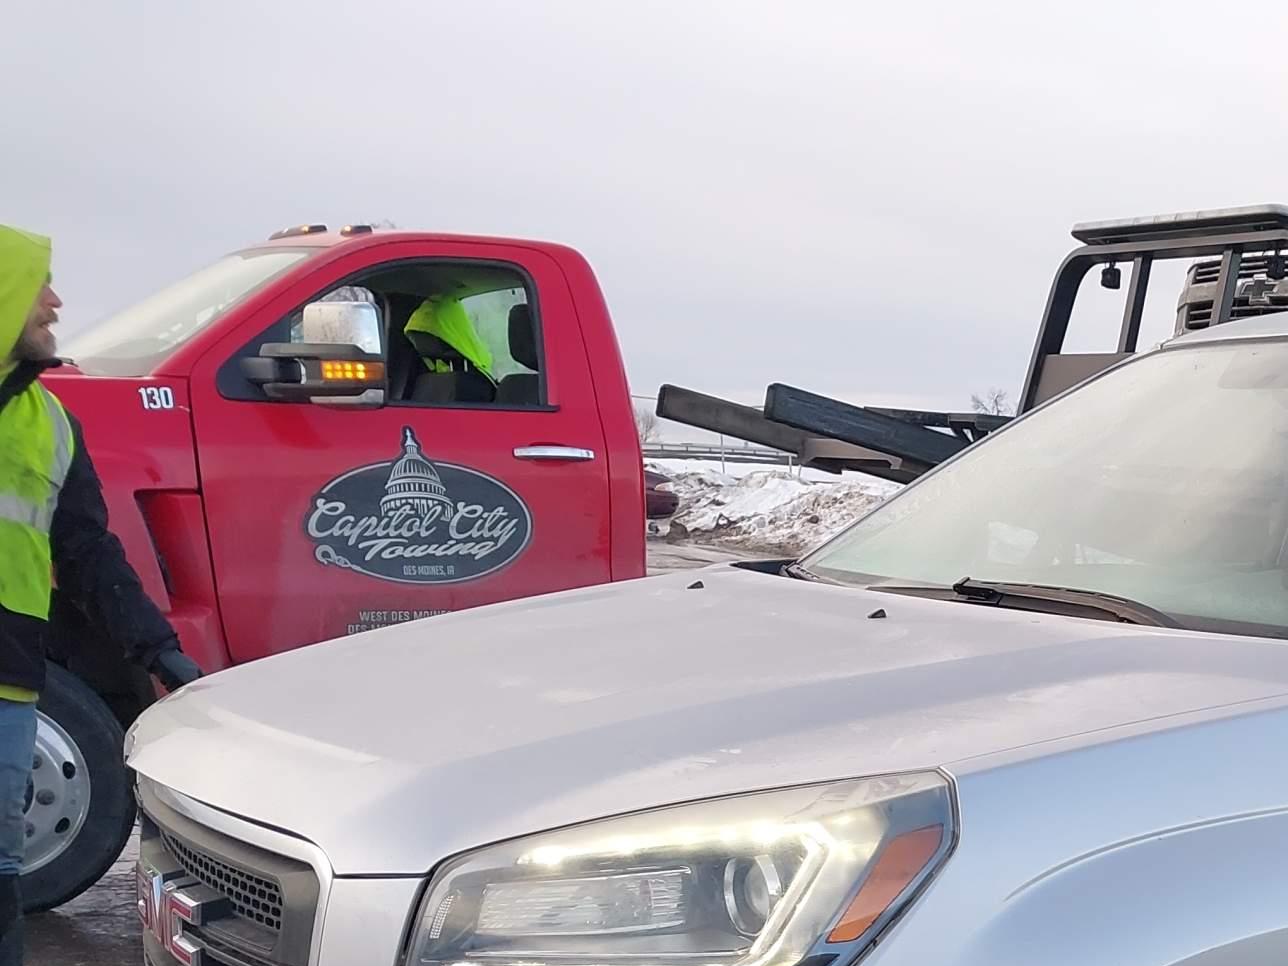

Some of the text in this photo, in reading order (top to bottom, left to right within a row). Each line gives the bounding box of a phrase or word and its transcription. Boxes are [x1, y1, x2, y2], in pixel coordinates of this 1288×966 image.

[138, 386, 174, 409] 130
[307, 498, 519, 548] Capitol City
[358, 538, 499, 561] Towing
[403, 565, 417, 576] DES
[359, 611, 388, 621] WEST
[391, 611, 410, 621] DES
